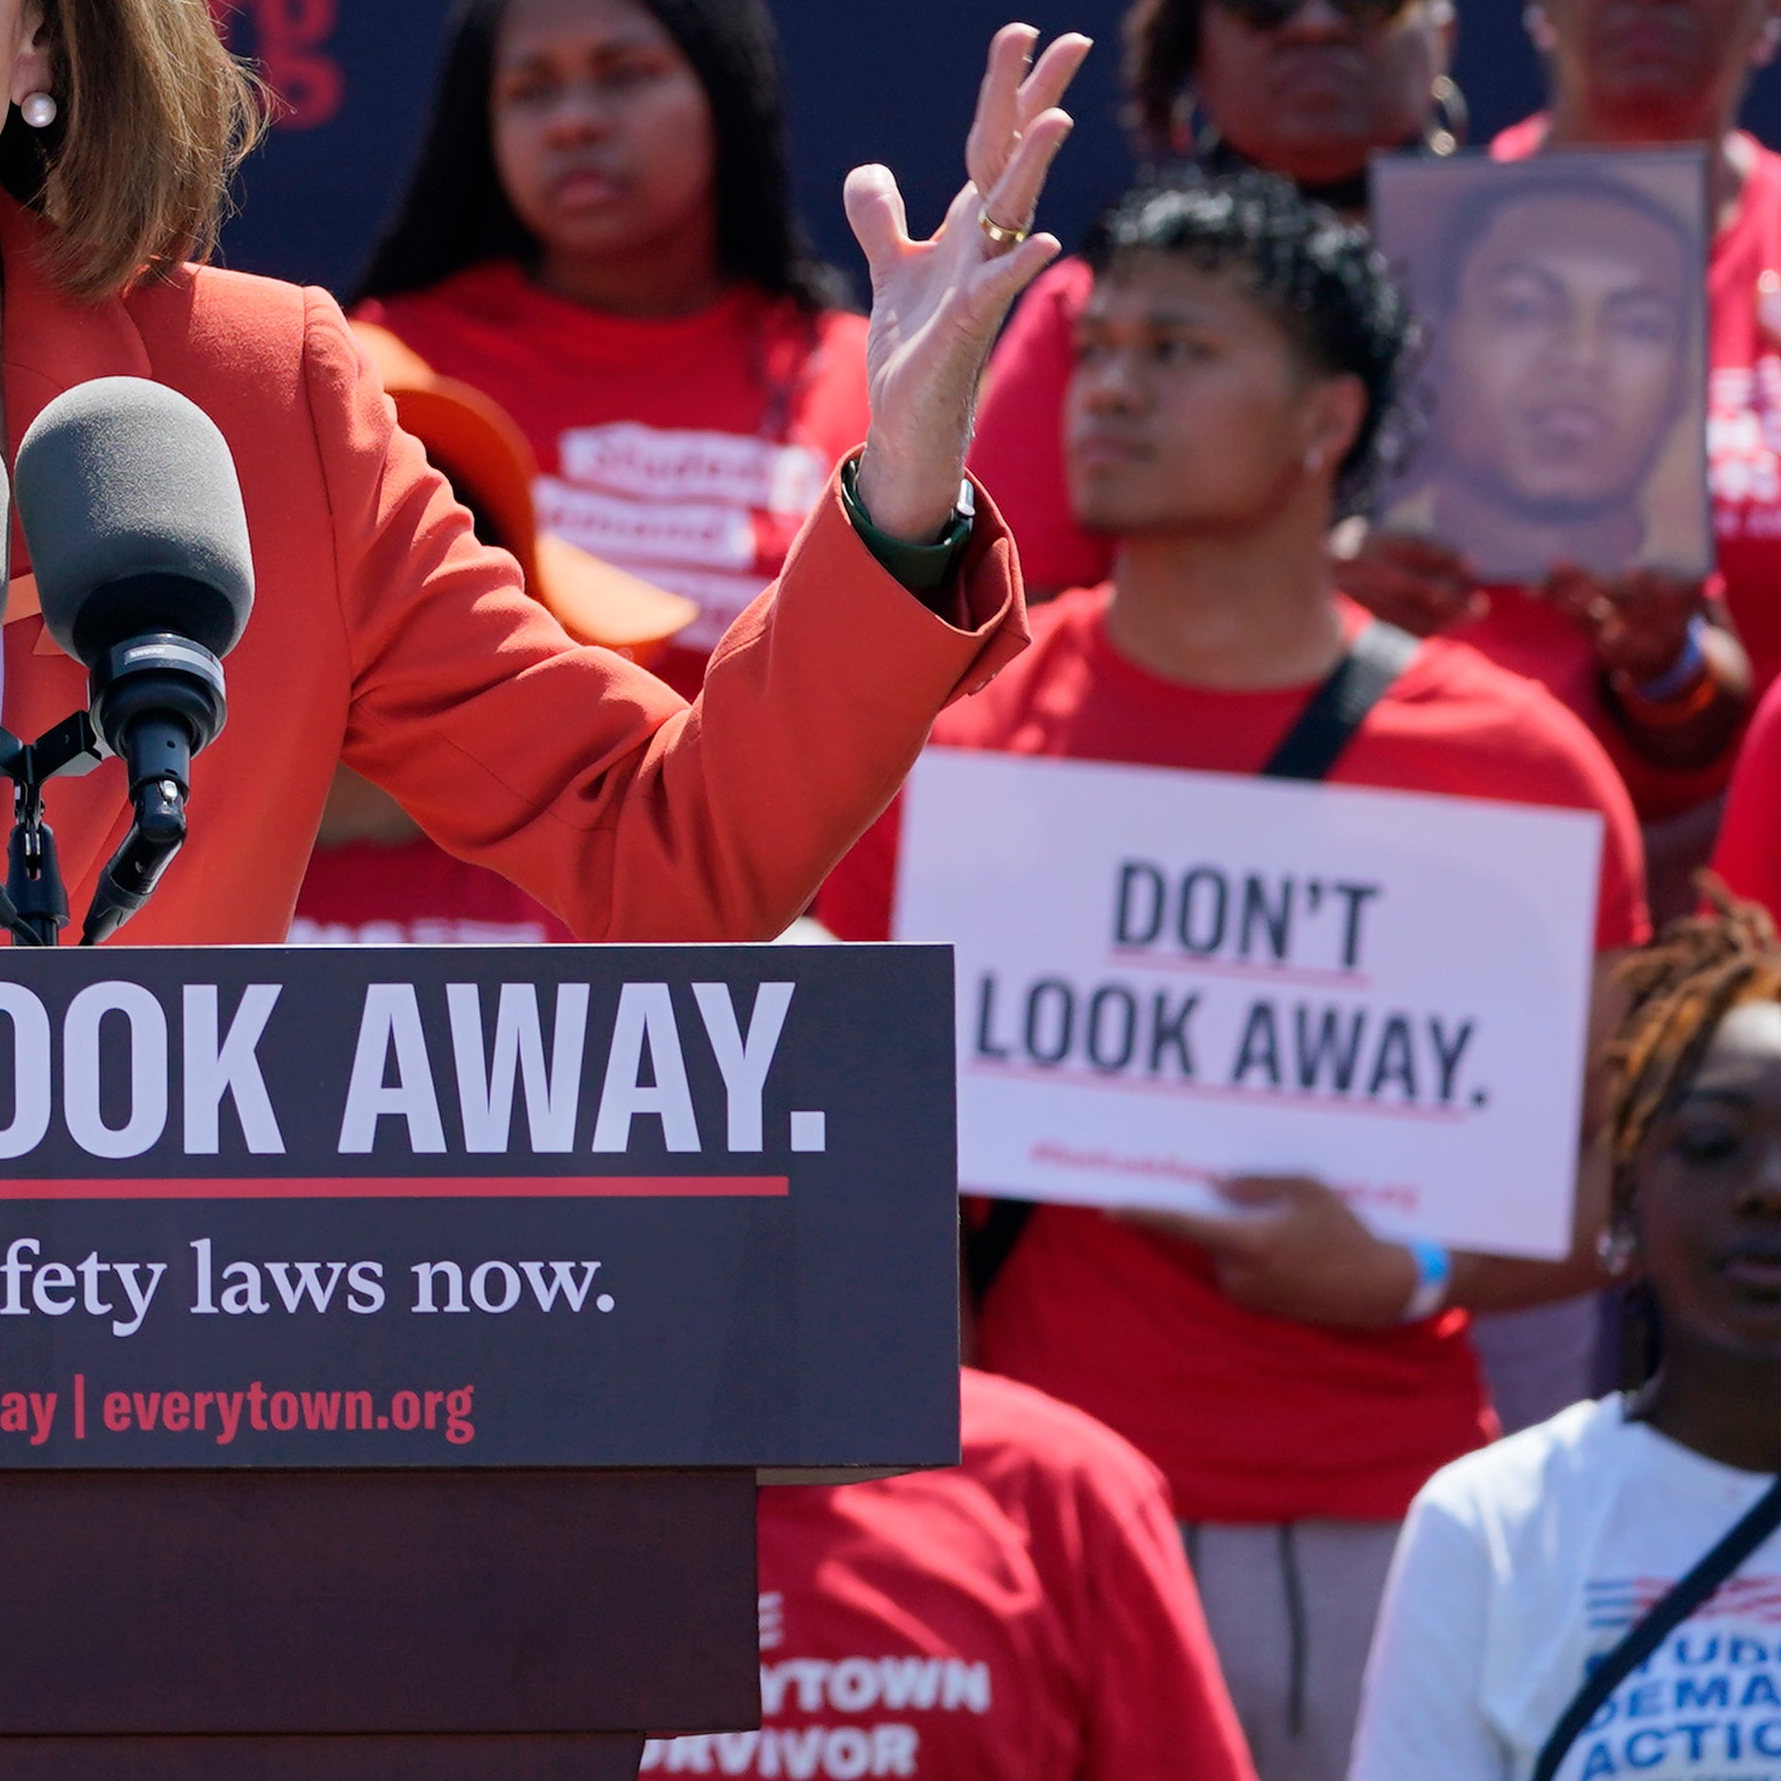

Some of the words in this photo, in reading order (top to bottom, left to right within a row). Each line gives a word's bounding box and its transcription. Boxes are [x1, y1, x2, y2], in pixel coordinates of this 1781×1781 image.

[1112, 859, 1381, 971] DON'T
[337, 982, 826, 1153] AWAY.
[973, 973, 1204, 1082] LOOK
[1235, 998, 1490, 1110] AWAY.
[190, 1239, 386, 1315] laws
[411, 1259, 615, 1314] now.
[103, 1381, 475, 1445] everytown.org
[760, 1656, 991, 1715] YTOWN
[639, 1723, 919, 1781] RVIVOR
